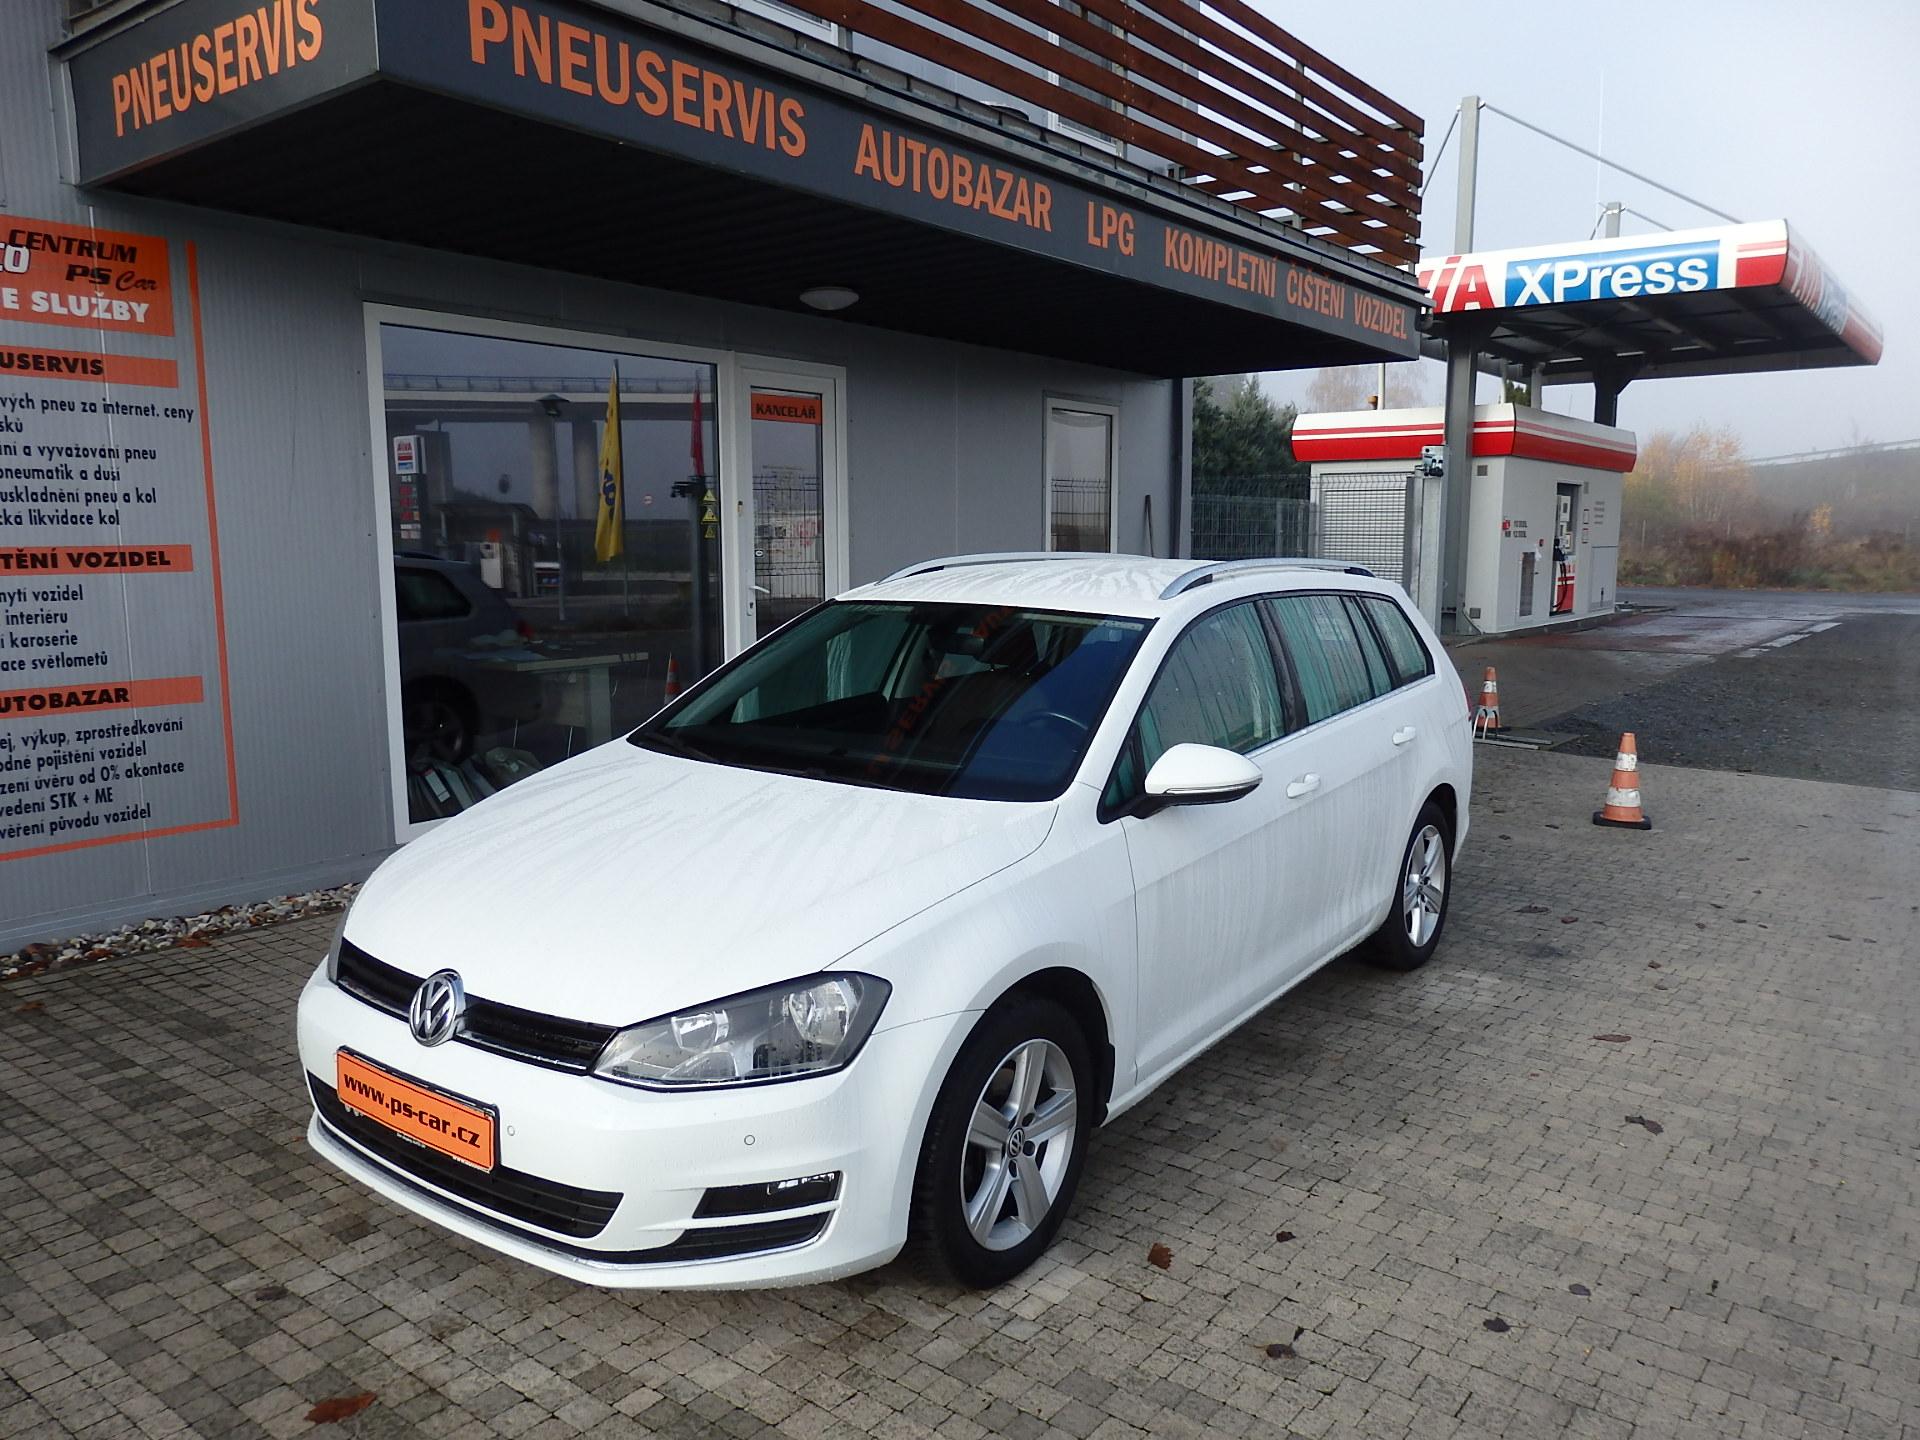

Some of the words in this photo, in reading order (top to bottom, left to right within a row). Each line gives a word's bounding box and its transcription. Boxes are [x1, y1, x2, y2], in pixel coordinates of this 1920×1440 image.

[112, 0, 323, 137] PNEUSERVIS
[468, 0, 806, 157] PNEUSERVIS
[854, 123, 1052, 232] AUTOBAZAR
[1087, 201, 1135, 256] LPG
[1164, 226, 1278, 298] KOMPLETNÍ
[1354, 292, 1407, 340] VOZIDEL
[9, 229, 137, 263] CENTRUM
[66, 264, 112, 285] PS
[115, 270, 157, 291] Car
[1513, 258, 1709, 306] XPress
[31, 291, 149, 323] SLUŽBY
[41, 399, 75, 414] pneu
[81, 401, 97, 413] za
[102, 398, 160, 417] internet.
[164, 407, 194, 423] ceny
[756, 403, 817, 419] KANCELÁŘ
[23, 445, 32, 456] a
[38, 443, 120, 461] vyvažování
[125, 449, 157, 463] pneu
[79, 470, 88, 480] a
[84, 493, 118, 506] pneu
[122, 492, 131, 503] a
[135, 487, 157, 503] kol
[29, 509, 94, 525] likvidace
[99, 509, 120, 525] kol
[67, 550, 171, 568] VOZIDEL
[33, 584, 84, 602] vozidel
[5, 608, 68, 625] interiéru
[9, 630, 78, 648] karoserie
[32, 651, 108, 670] světlometů
[21, 729, 70, 750] výkup,
[75, 717, 183, 744] zprostředkování
[37, 748, 95, 772] pojištění
[99, 740, 147, 760] vozidel
[35, 774, 74, 790] úvěru
[79, 768, 96, 784] od
[100, 764, 120, 781] 0%
[125, 761, 185, 779] akontace
[50, 791, 78, 810] STK
[95, 786, 113, 803] ME
[50, 811, 99, 836] původu
[104, 802, 151, 822] vozidel
[344, 1073, 481, 1149] www.ps-car.cz
